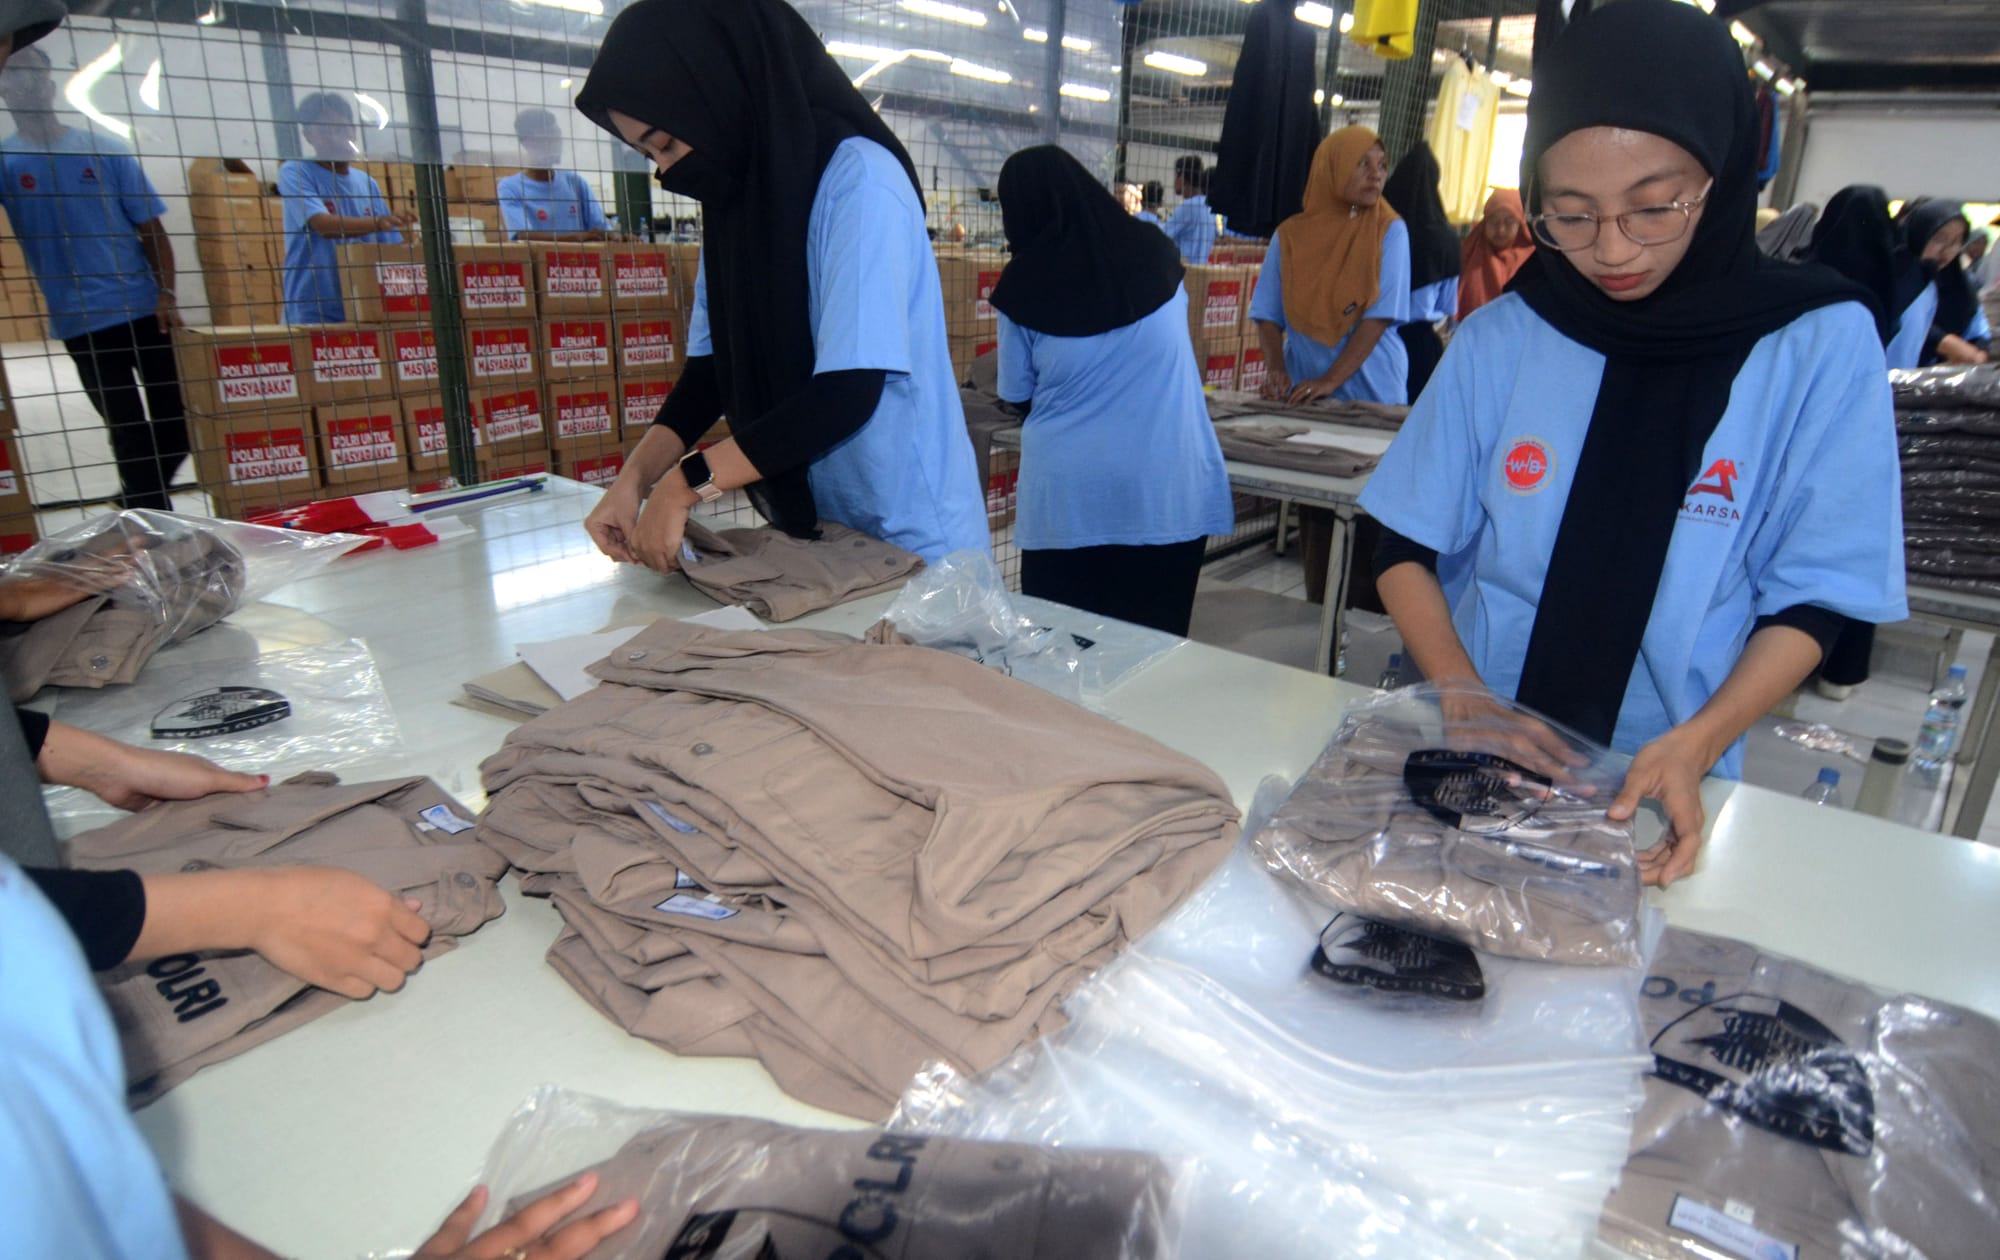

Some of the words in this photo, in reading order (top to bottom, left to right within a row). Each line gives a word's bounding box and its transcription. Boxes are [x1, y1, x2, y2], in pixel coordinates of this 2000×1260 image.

[641, 266, 663, 278] UNTUK
[493, 275, 520, 287] UNTUK
[315, 347, 343, 360] POLRI
[344, 346, 376, 358] UNTUK
[400, 347, 427, 360] POLRI
[220, 363, 253, 378] POLRI
[254, 361, 289, 375] UNTUK
[224, 379, 292, 398] MASYARAKAT
[332, 434, 359, 449] POLRI
[360, 430, 391, 446] UNTUK
[231, 447, 264, 463] POLRI
[265, 444, 302, 459] UNTUK
